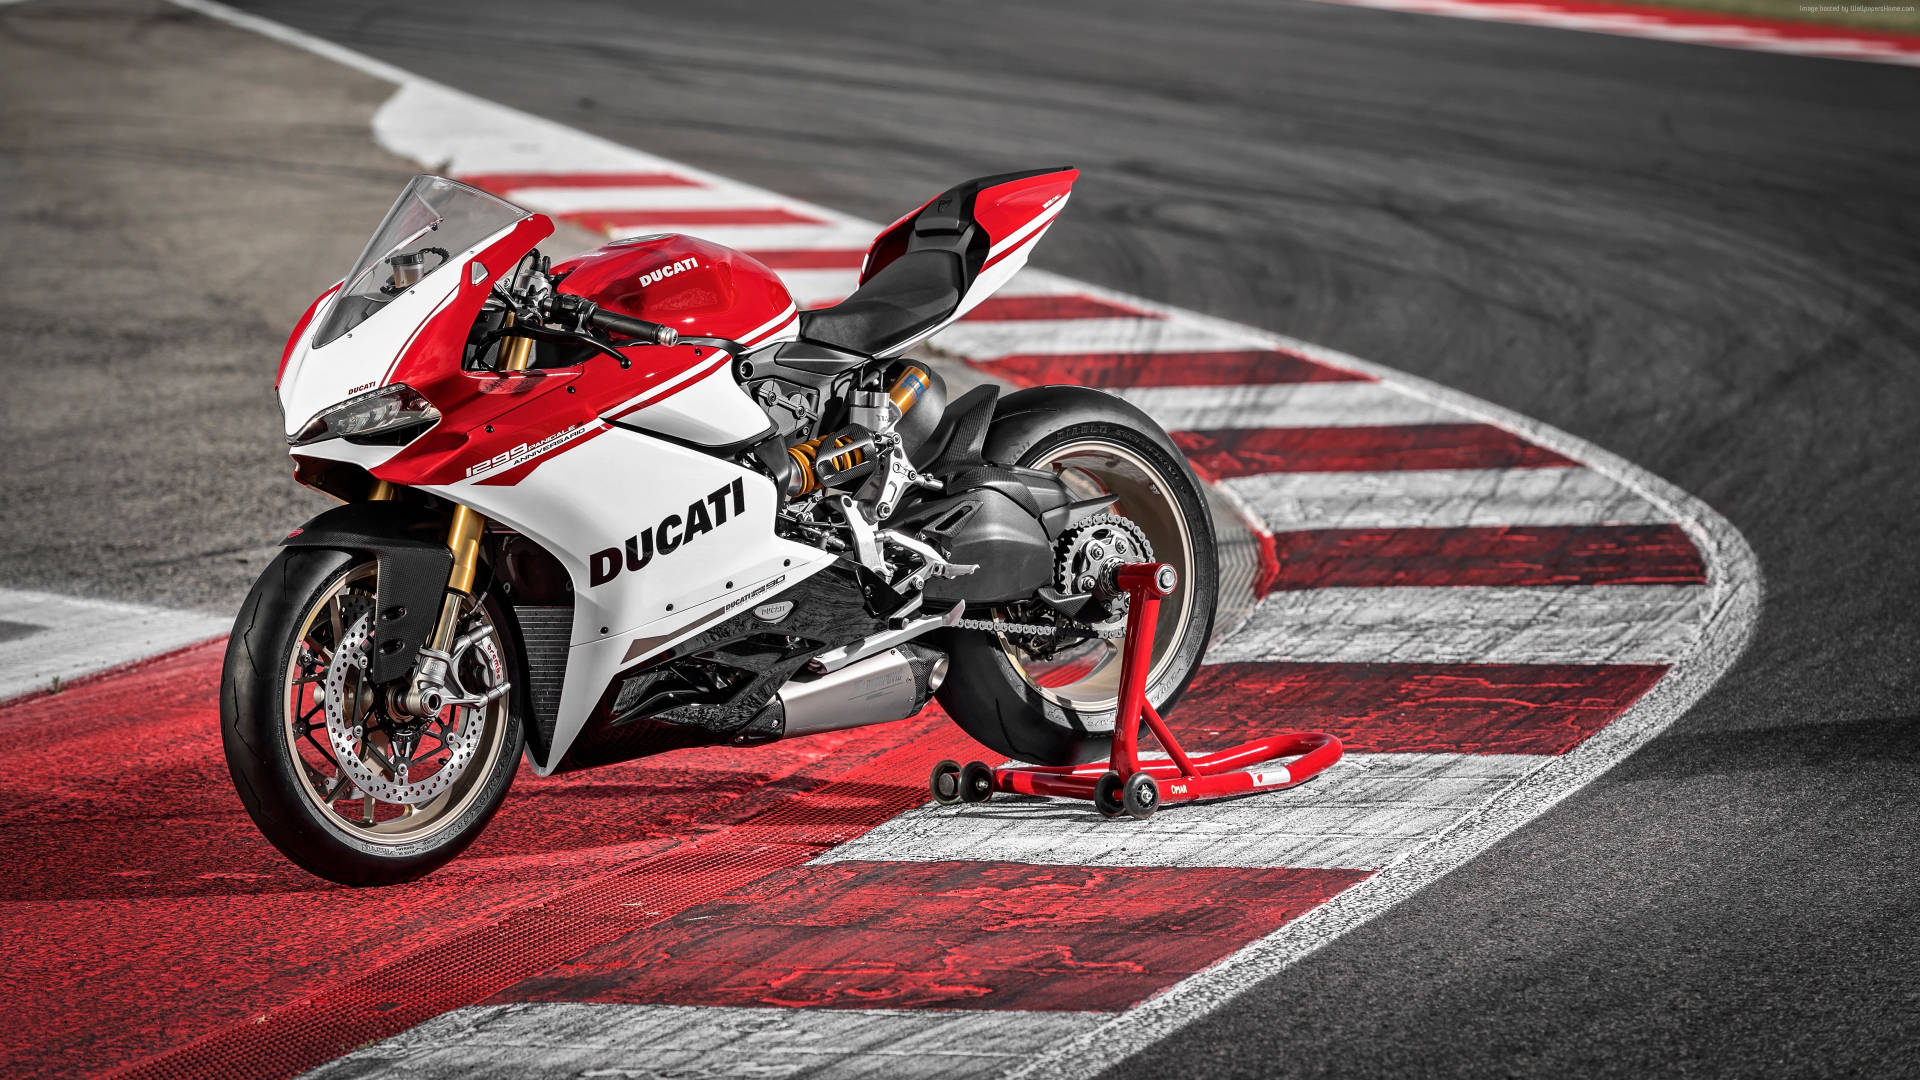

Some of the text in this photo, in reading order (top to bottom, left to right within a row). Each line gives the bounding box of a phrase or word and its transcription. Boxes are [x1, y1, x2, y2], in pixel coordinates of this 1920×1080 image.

[639, 257, 698, 287] DUCATI
[348, 381, 376, 395] DUCATI
[465, 424, 576, 478] 1299 PANIGALE
[513, 427, 586, 466] ANNIVERSARIO
[590, 476, 745, 588] DUCATI
[725, 593, 751, 611] DUCATI
[761, 605, 785, 616] DUCATI
[487, 644, 501, 681] brembo
